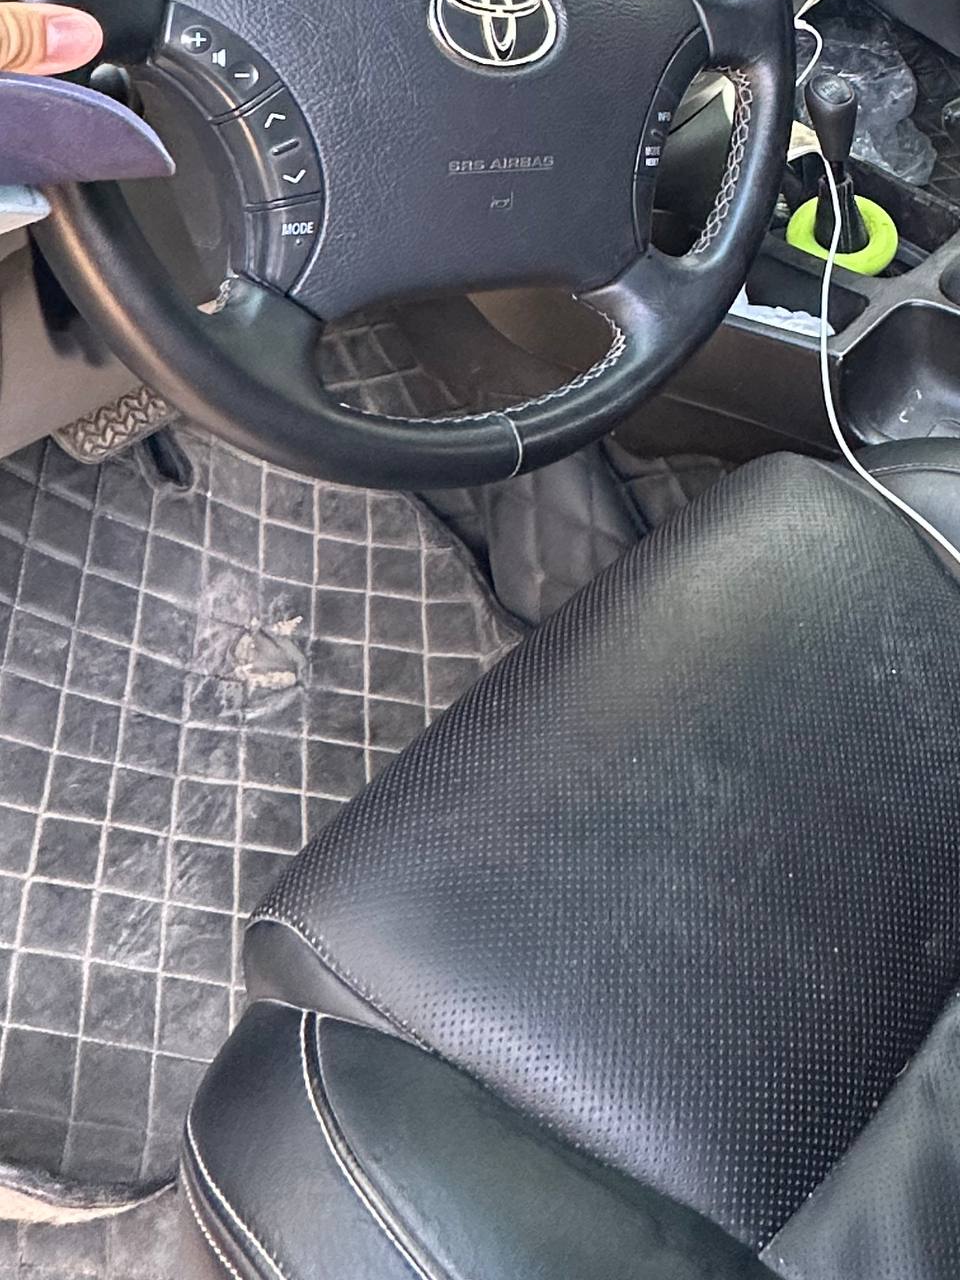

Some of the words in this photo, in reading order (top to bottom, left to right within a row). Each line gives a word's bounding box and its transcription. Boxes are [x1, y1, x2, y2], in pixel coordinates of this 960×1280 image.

[448, 160, 485, 171] SRS
[489, 155, 554, 169] AIRBAG
[281, 221, 314, 236] MODE
